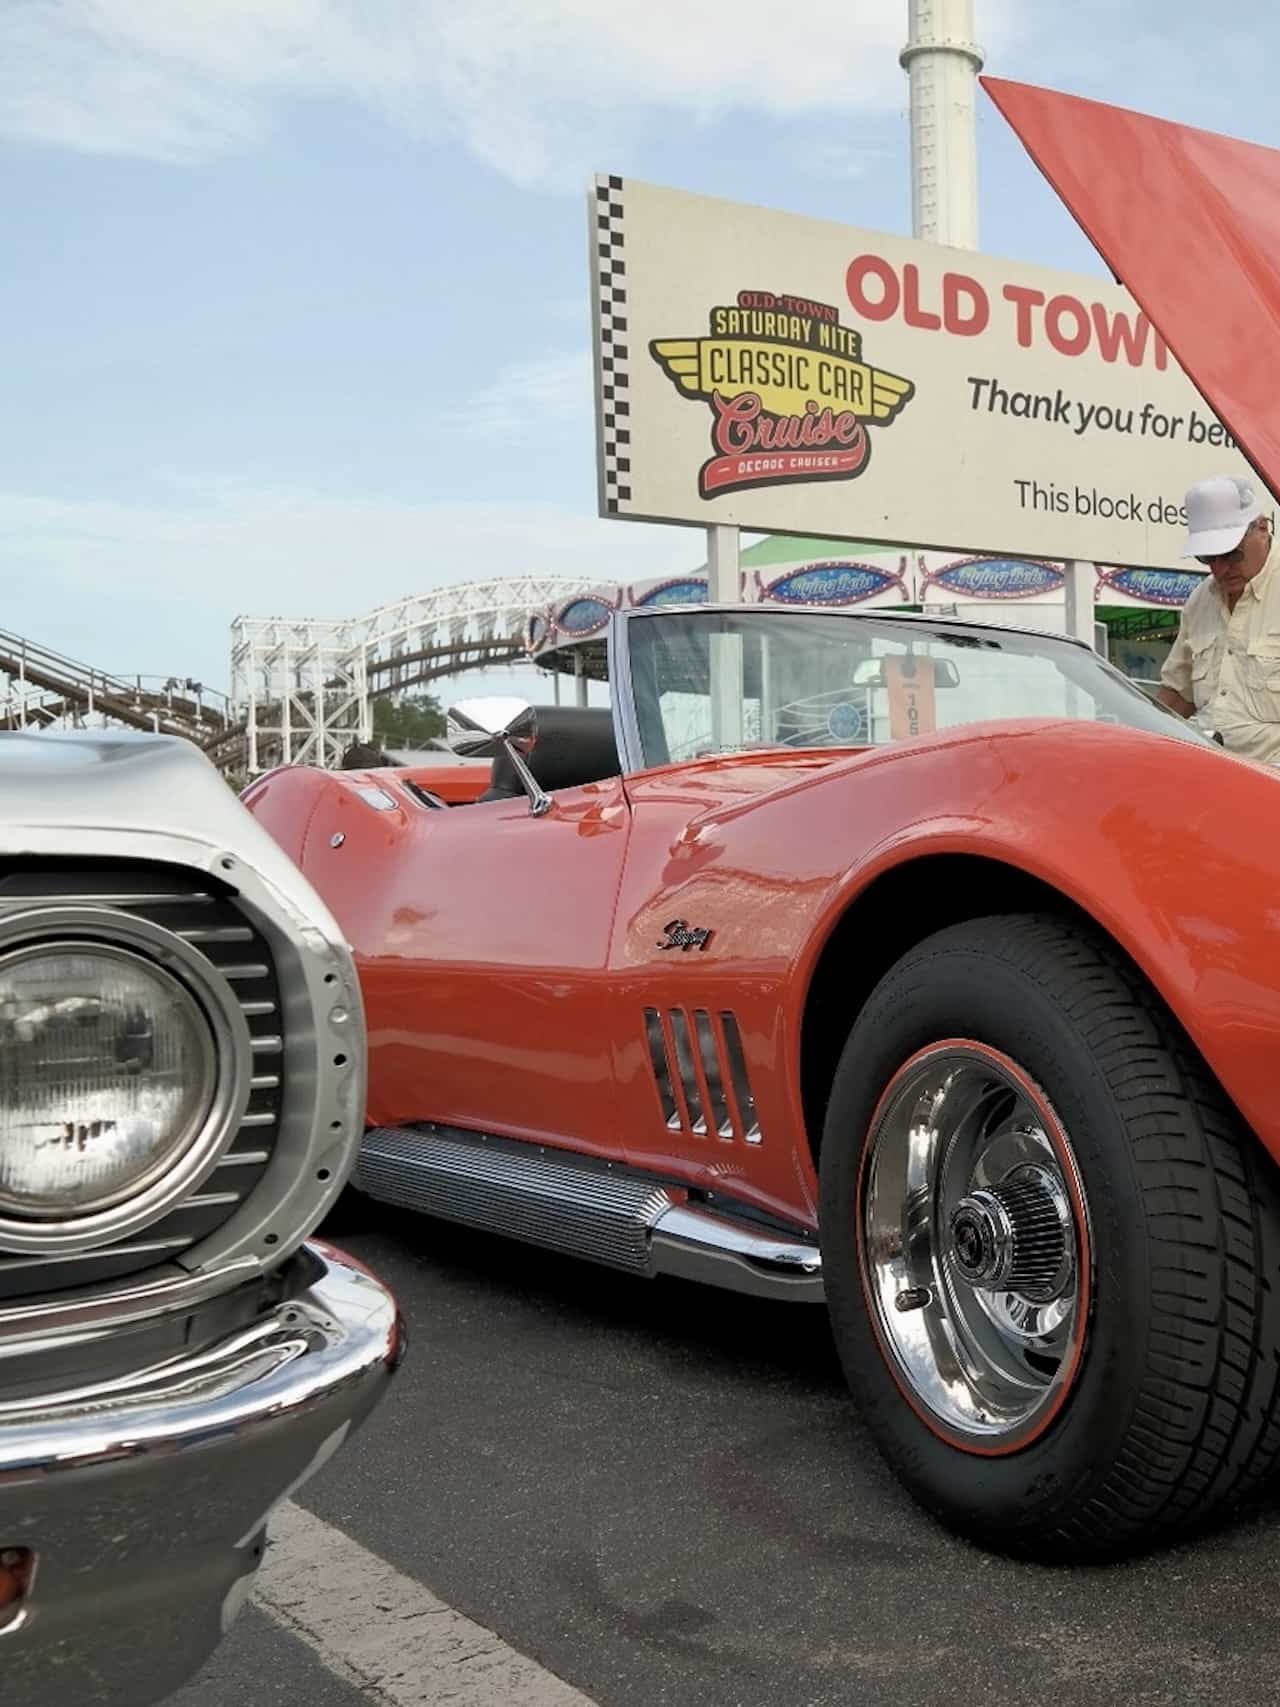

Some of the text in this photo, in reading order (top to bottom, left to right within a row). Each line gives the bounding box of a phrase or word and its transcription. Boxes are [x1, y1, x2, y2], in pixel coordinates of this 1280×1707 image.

[845, 254, 990, 337] OLD
[716, 310, 858, 357] SATURDAY NITE
[711, 348, 864, 405] CLASSIC CAR
[712, 388, 858, 455] Cruise
[967, 377, 1071, 424] Thank
[1073, 402, 1133, 435] you
[1140, 403, 1183, 439] for
[738, 459, 785, 474] DECADE
[1014, 479, 1069, 513] This
[1075, 486, 1143, 522] block
